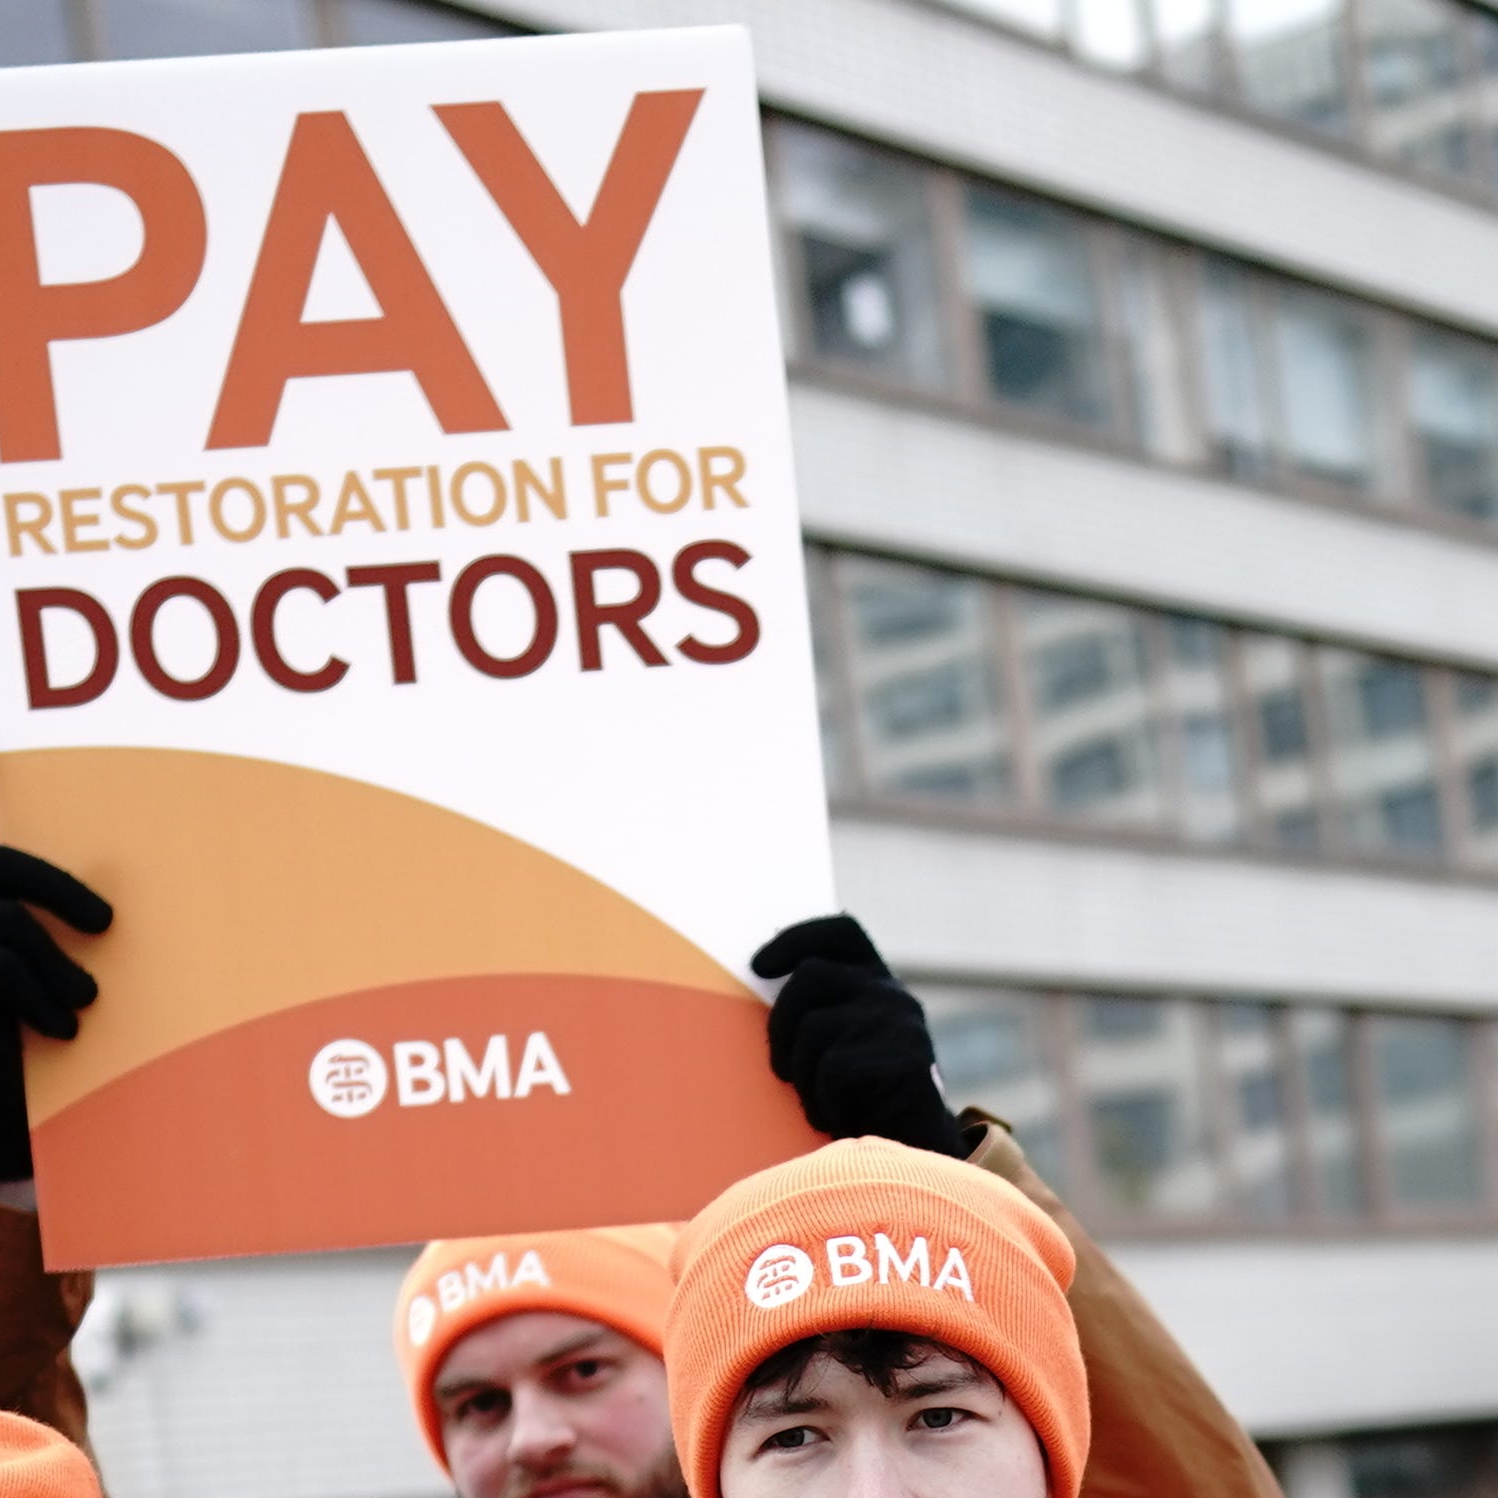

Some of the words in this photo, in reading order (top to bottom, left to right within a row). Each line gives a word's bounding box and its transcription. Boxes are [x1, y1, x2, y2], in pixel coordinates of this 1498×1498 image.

[1, 456, 570, 557] RESTORATION
[590, 445, 750, 519] FOR
[14, 538, 761, 711] DOCTORS
[393, 1030, 572, 1107] BMA
[437, 1248, 552, 1313] BMA
[826, 1232, 976, 1305] BMA
